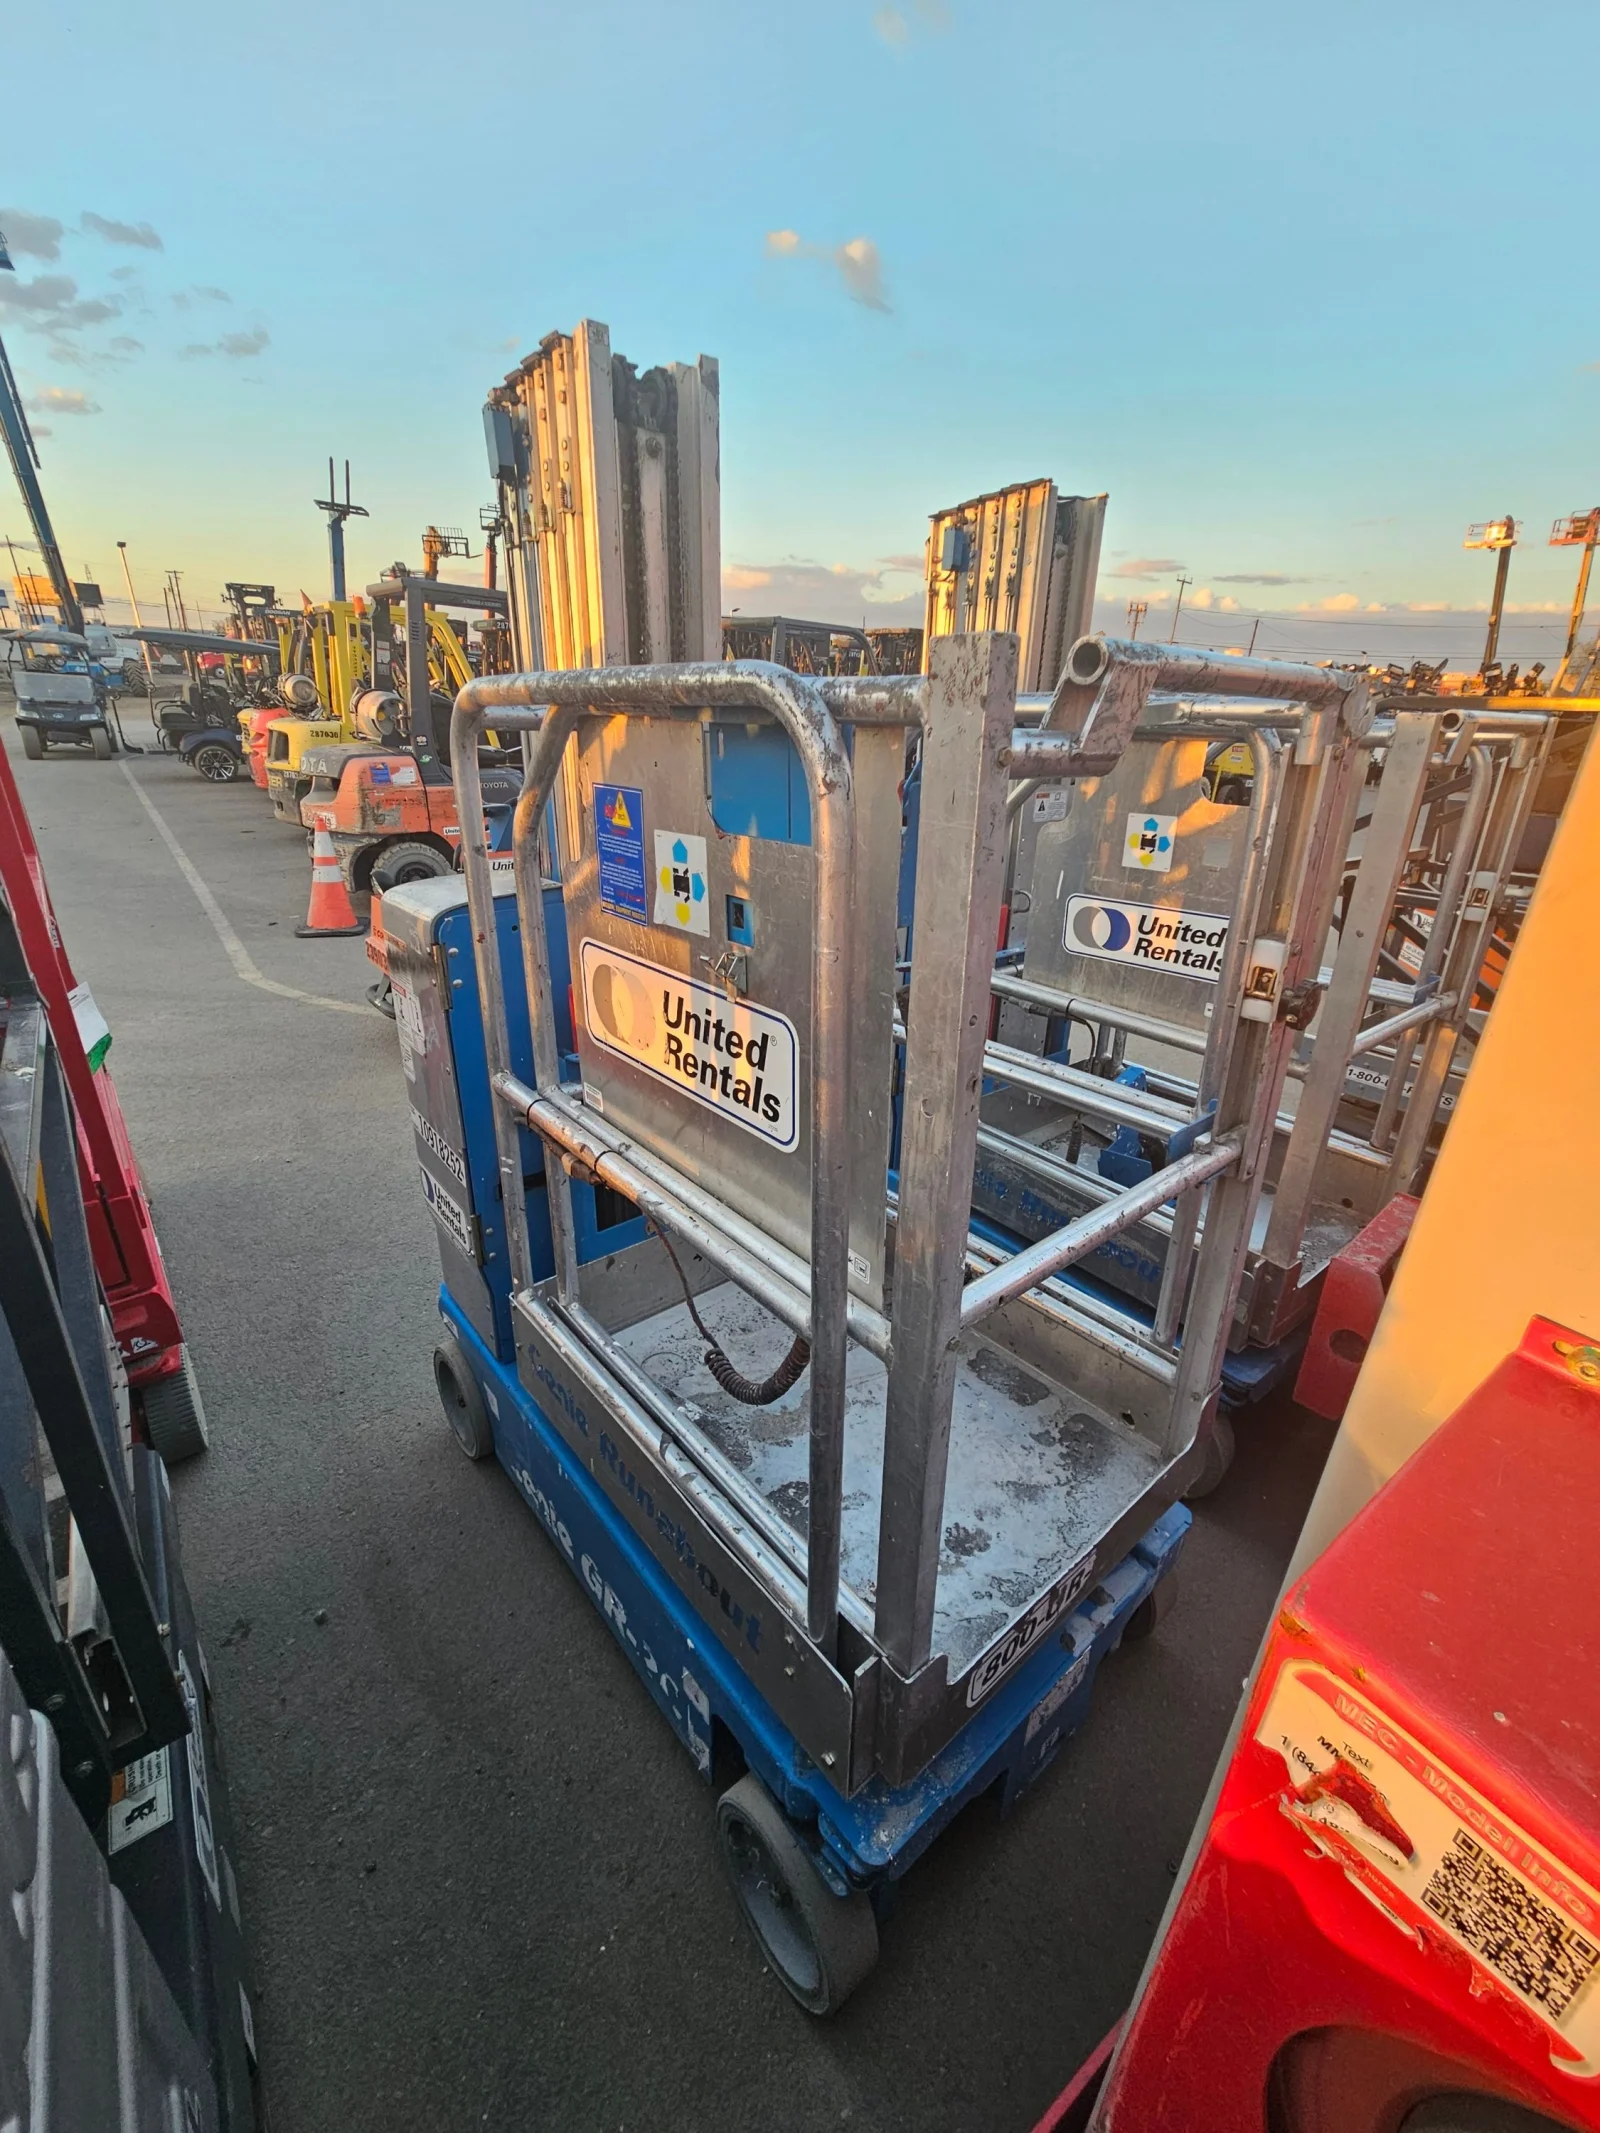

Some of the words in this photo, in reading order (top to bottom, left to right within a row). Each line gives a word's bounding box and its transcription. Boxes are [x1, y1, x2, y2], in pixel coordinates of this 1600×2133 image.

[310, 729, 339, 739] 287030
[1137, 914, 1228, 949] United
[664, 990, 769, 1073] United
[664, 1032, 781, 1123] Rentals
[434, 1182, 461, 1225] United
[436, 1200, 467, 1245] Rentals
[511, 1464, 575, 1560] enie
[600, 1431, 762, 1655] Runabout
[1342, 1741, 1370, 1769] Text
[1334, 1694, 1398, 1750] MEC
[1421, 1765, 1515, 1851] Model
[1521, 1853, 1587, 1916] Info
